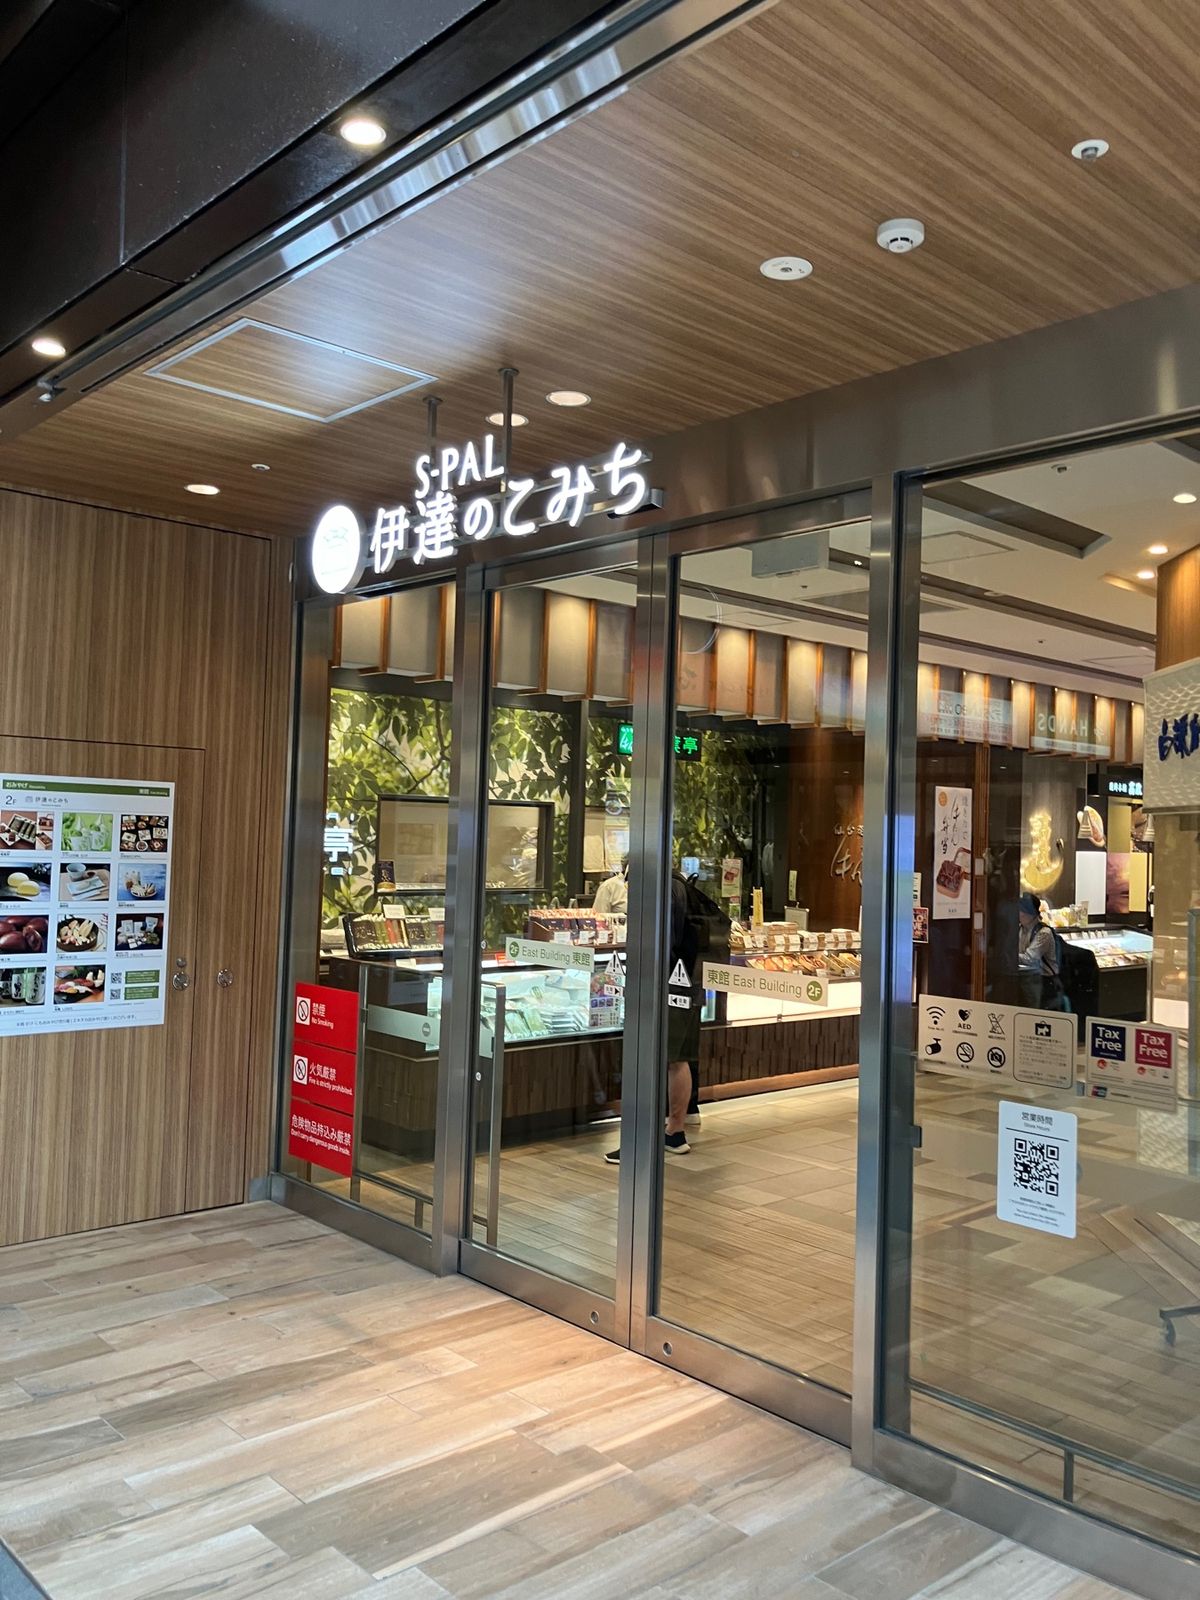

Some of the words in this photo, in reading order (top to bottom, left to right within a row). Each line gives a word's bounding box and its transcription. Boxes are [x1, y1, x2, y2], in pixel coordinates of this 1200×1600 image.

[414, 433, 505, 499] S-PAL
[369, 441, 647, 574] 伊達のこみち
[5, 795, 16, 806] 2F
[522, 946, 538, 958] East
[540, 948, 570, 965] Building
[572, 951, 590, 966] 東館
[706, 969, 730, 986] 東館
[732, 975, 756, 989] East
[758, 978, 802, 998] Building
[806, 984, 821, 997] 2F
[312, 1003, 326, 1018] 禁煙
[317, 1018, 334, 1030] Smoking
[957, 1023, 972, 1031] AED
[1096, 1026, 1120, 1040] Tax
[1141, 1033, 1166, 1046] Tax
[1094, 1038, 1122, 1052] Free
[1139, 1044, 1168, 1059] Free
[309, 1063, 337, 1081] 火気厳禁
[319, 1080, 332, 1092] strictly
[1021, 1111, 1053, 1126] 営業時間
